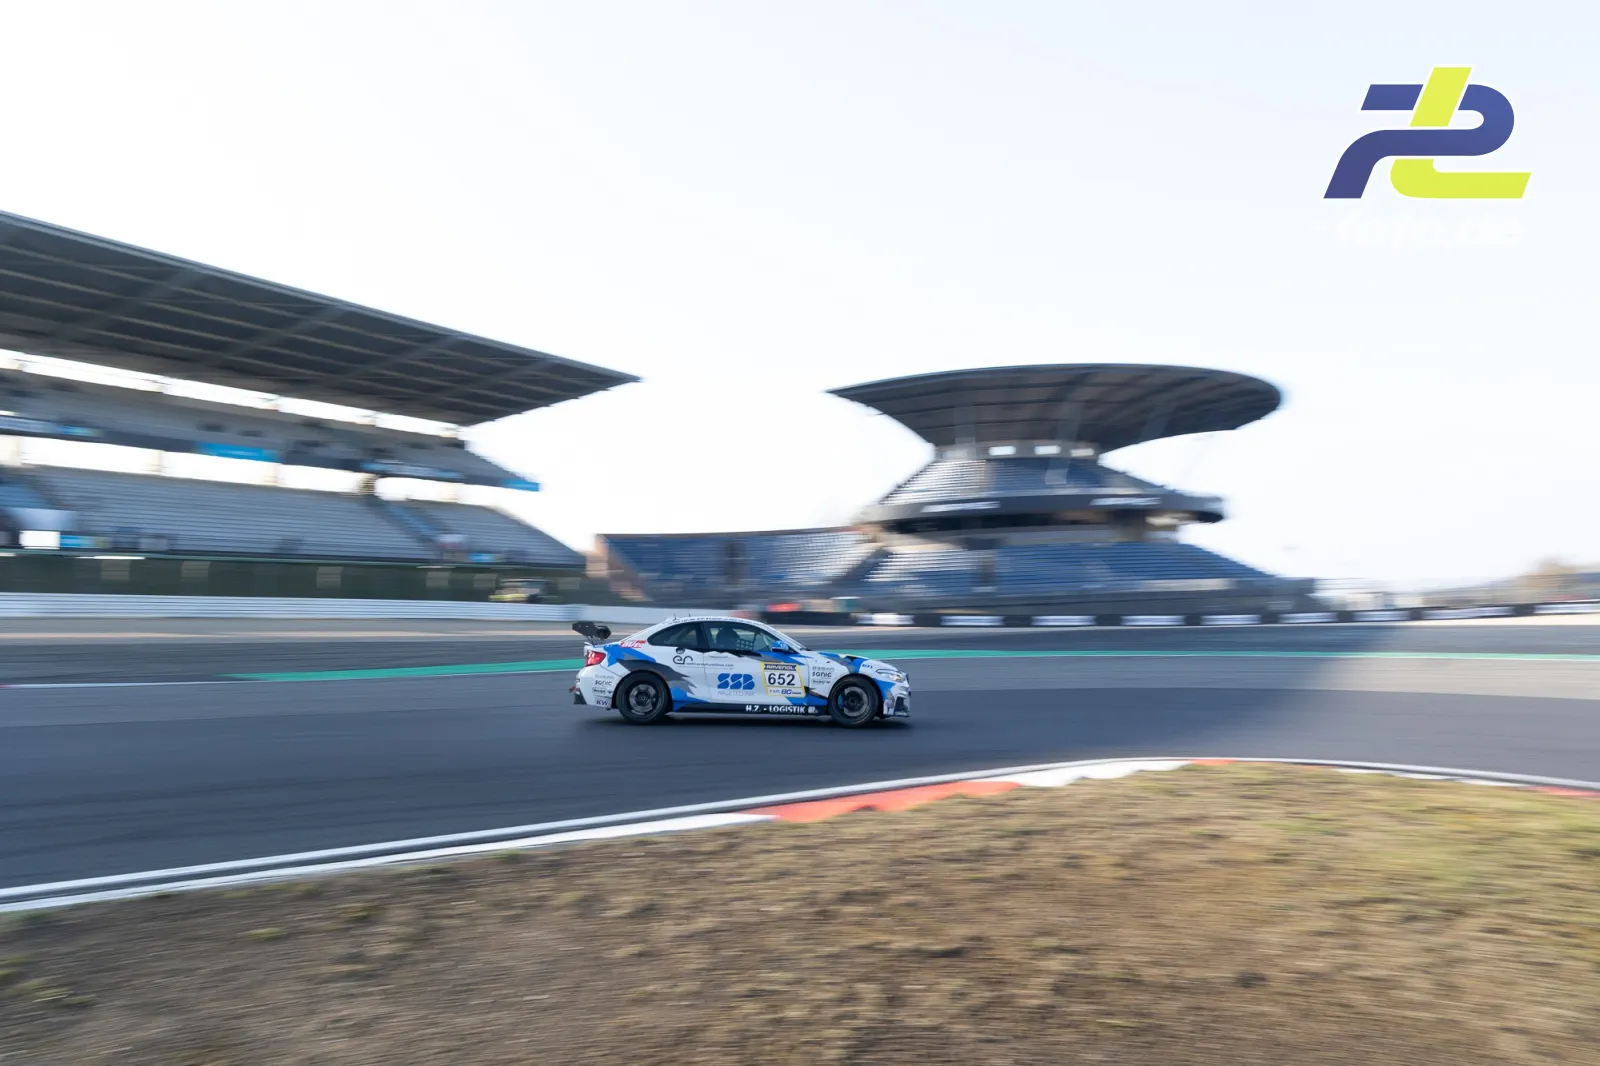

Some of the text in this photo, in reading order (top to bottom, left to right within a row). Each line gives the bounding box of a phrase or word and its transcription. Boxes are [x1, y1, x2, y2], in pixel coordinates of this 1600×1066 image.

[717, 673, 755, 690] SSB
[768, 673, 796, 686] 652
[769, 705, 806, 714] LOGISTIK
